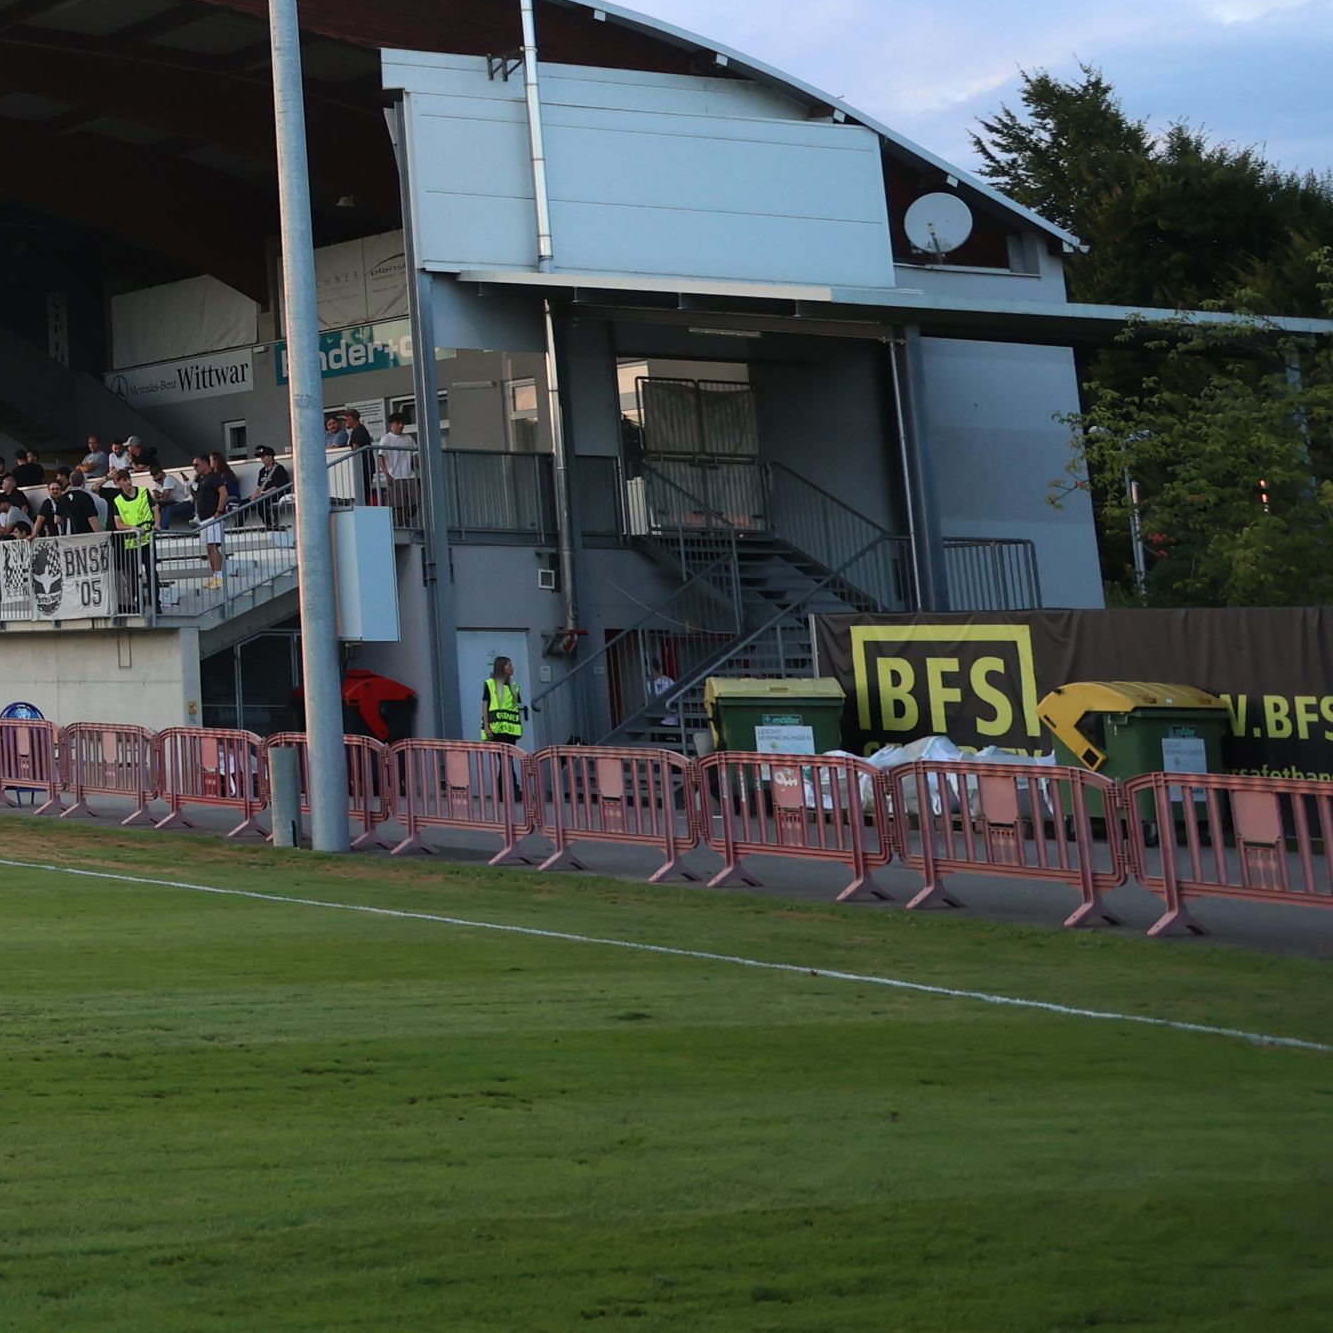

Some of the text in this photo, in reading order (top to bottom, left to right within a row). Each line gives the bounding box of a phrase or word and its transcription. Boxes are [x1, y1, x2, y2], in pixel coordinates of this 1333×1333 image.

[129, 363, 249, 396] Mercedes-Benz Wittwar
[876, 656, 1014, 737] BFS
